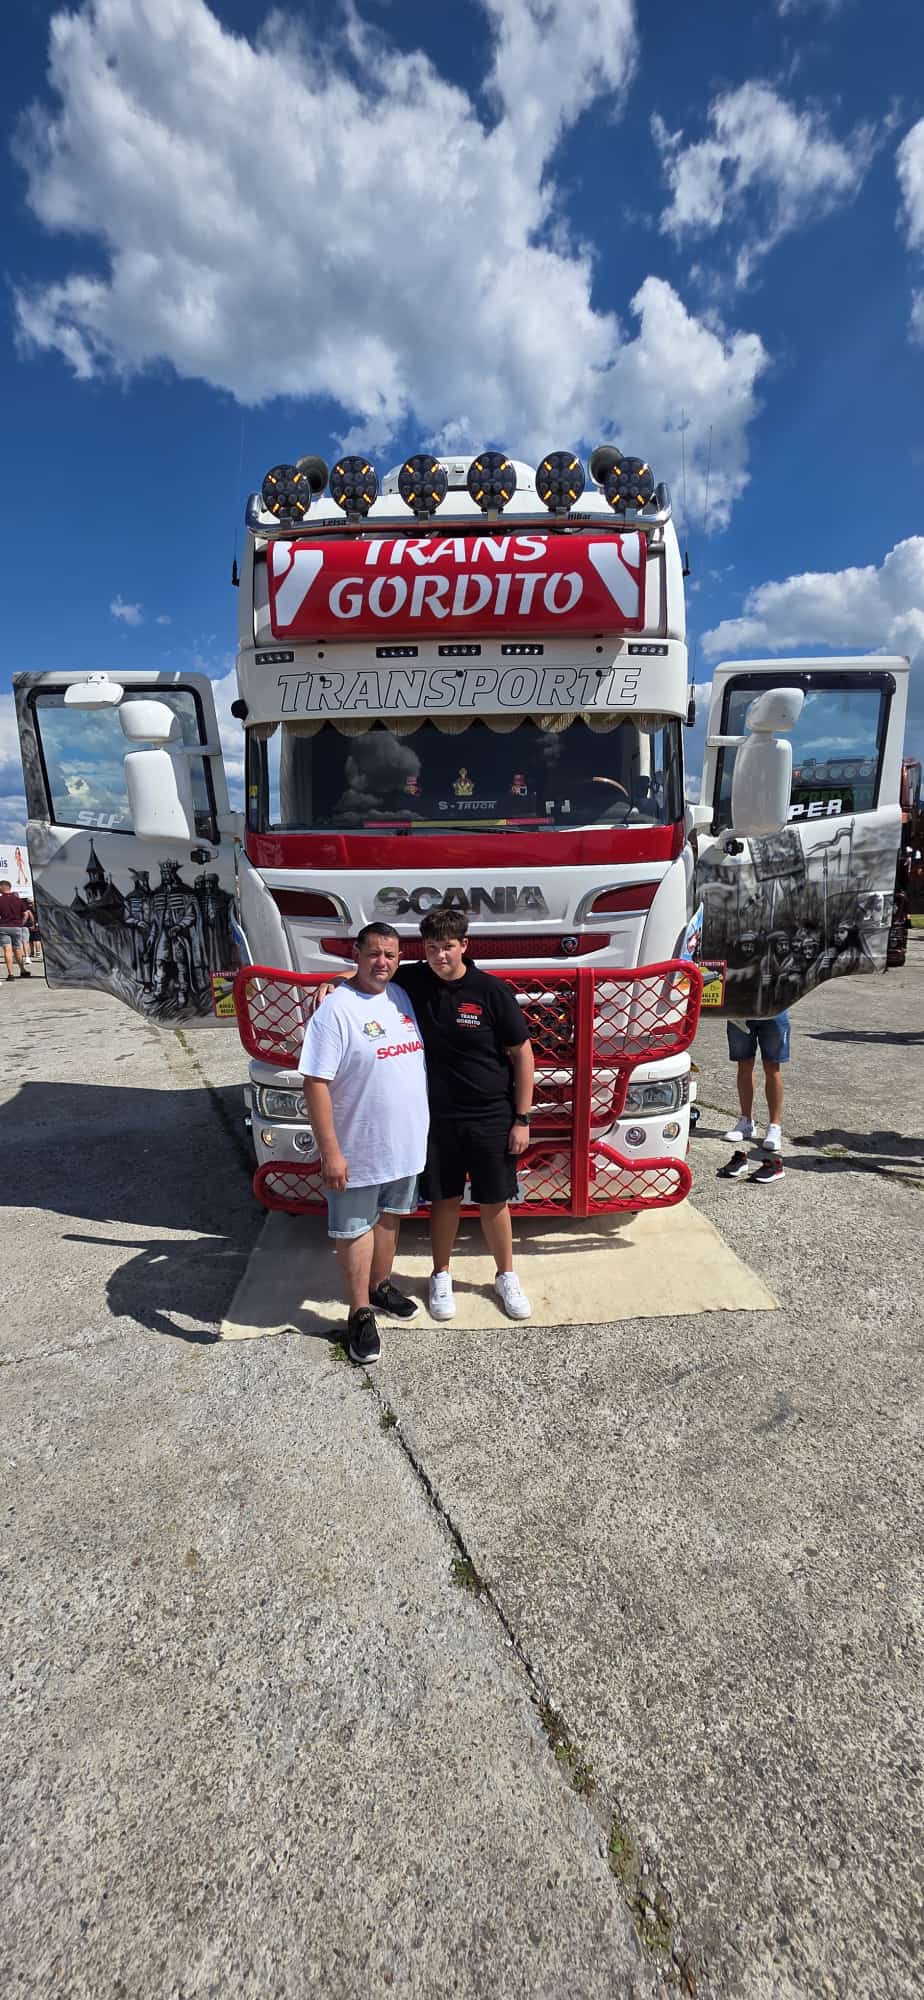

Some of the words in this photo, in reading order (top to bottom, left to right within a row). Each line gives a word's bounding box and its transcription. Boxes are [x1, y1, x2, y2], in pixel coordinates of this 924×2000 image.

[364, 535, 549, 566] TRANS
[328, 571, 584, 619] GORDITO
[277, 666, 641, 712] TRANSPORTE
[374, 886, 549, 915] SCANIA
[376, 1040, 423, 1060] SCANIA
